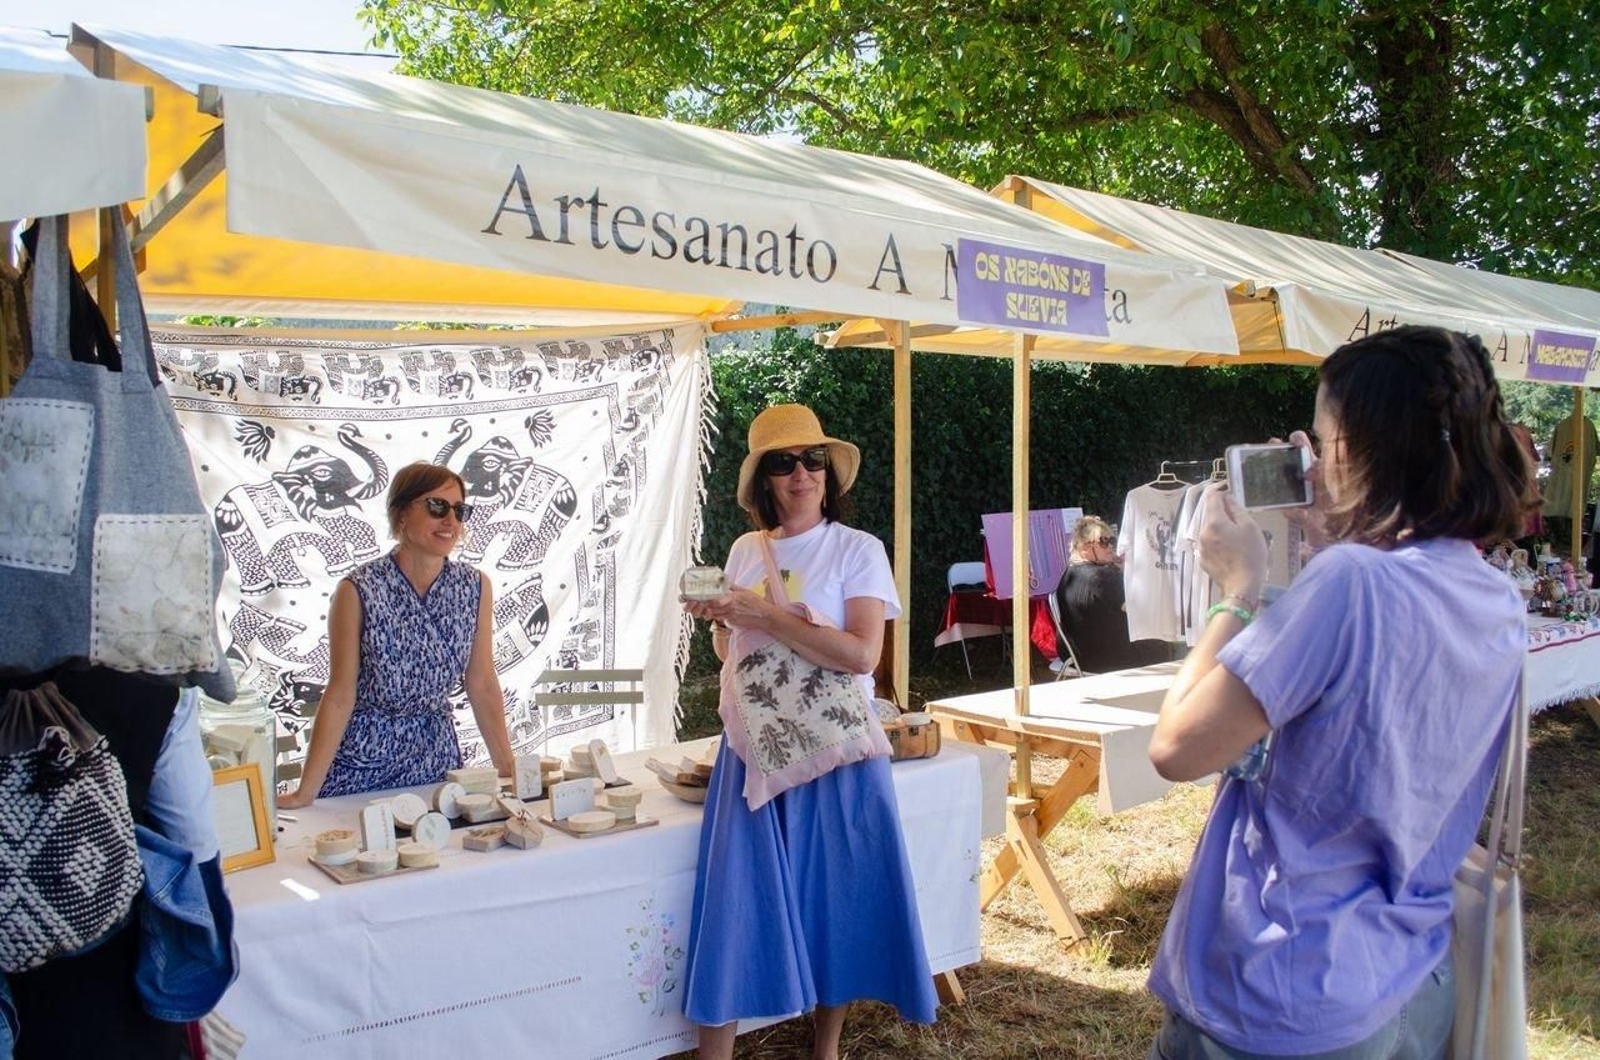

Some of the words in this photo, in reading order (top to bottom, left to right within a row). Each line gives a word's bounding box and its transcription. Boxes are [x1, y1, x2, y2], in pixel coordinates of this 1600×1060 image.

[480, 163, 837, 283] Artesanato
[867, 232, 912, 295] A
[975, 251, 1001, 282] OS
[1072, 267, 1091, 297] DE
[1005, 292, 1068, 325] SUEVIA
[1490, 329, 1508, 362] A
